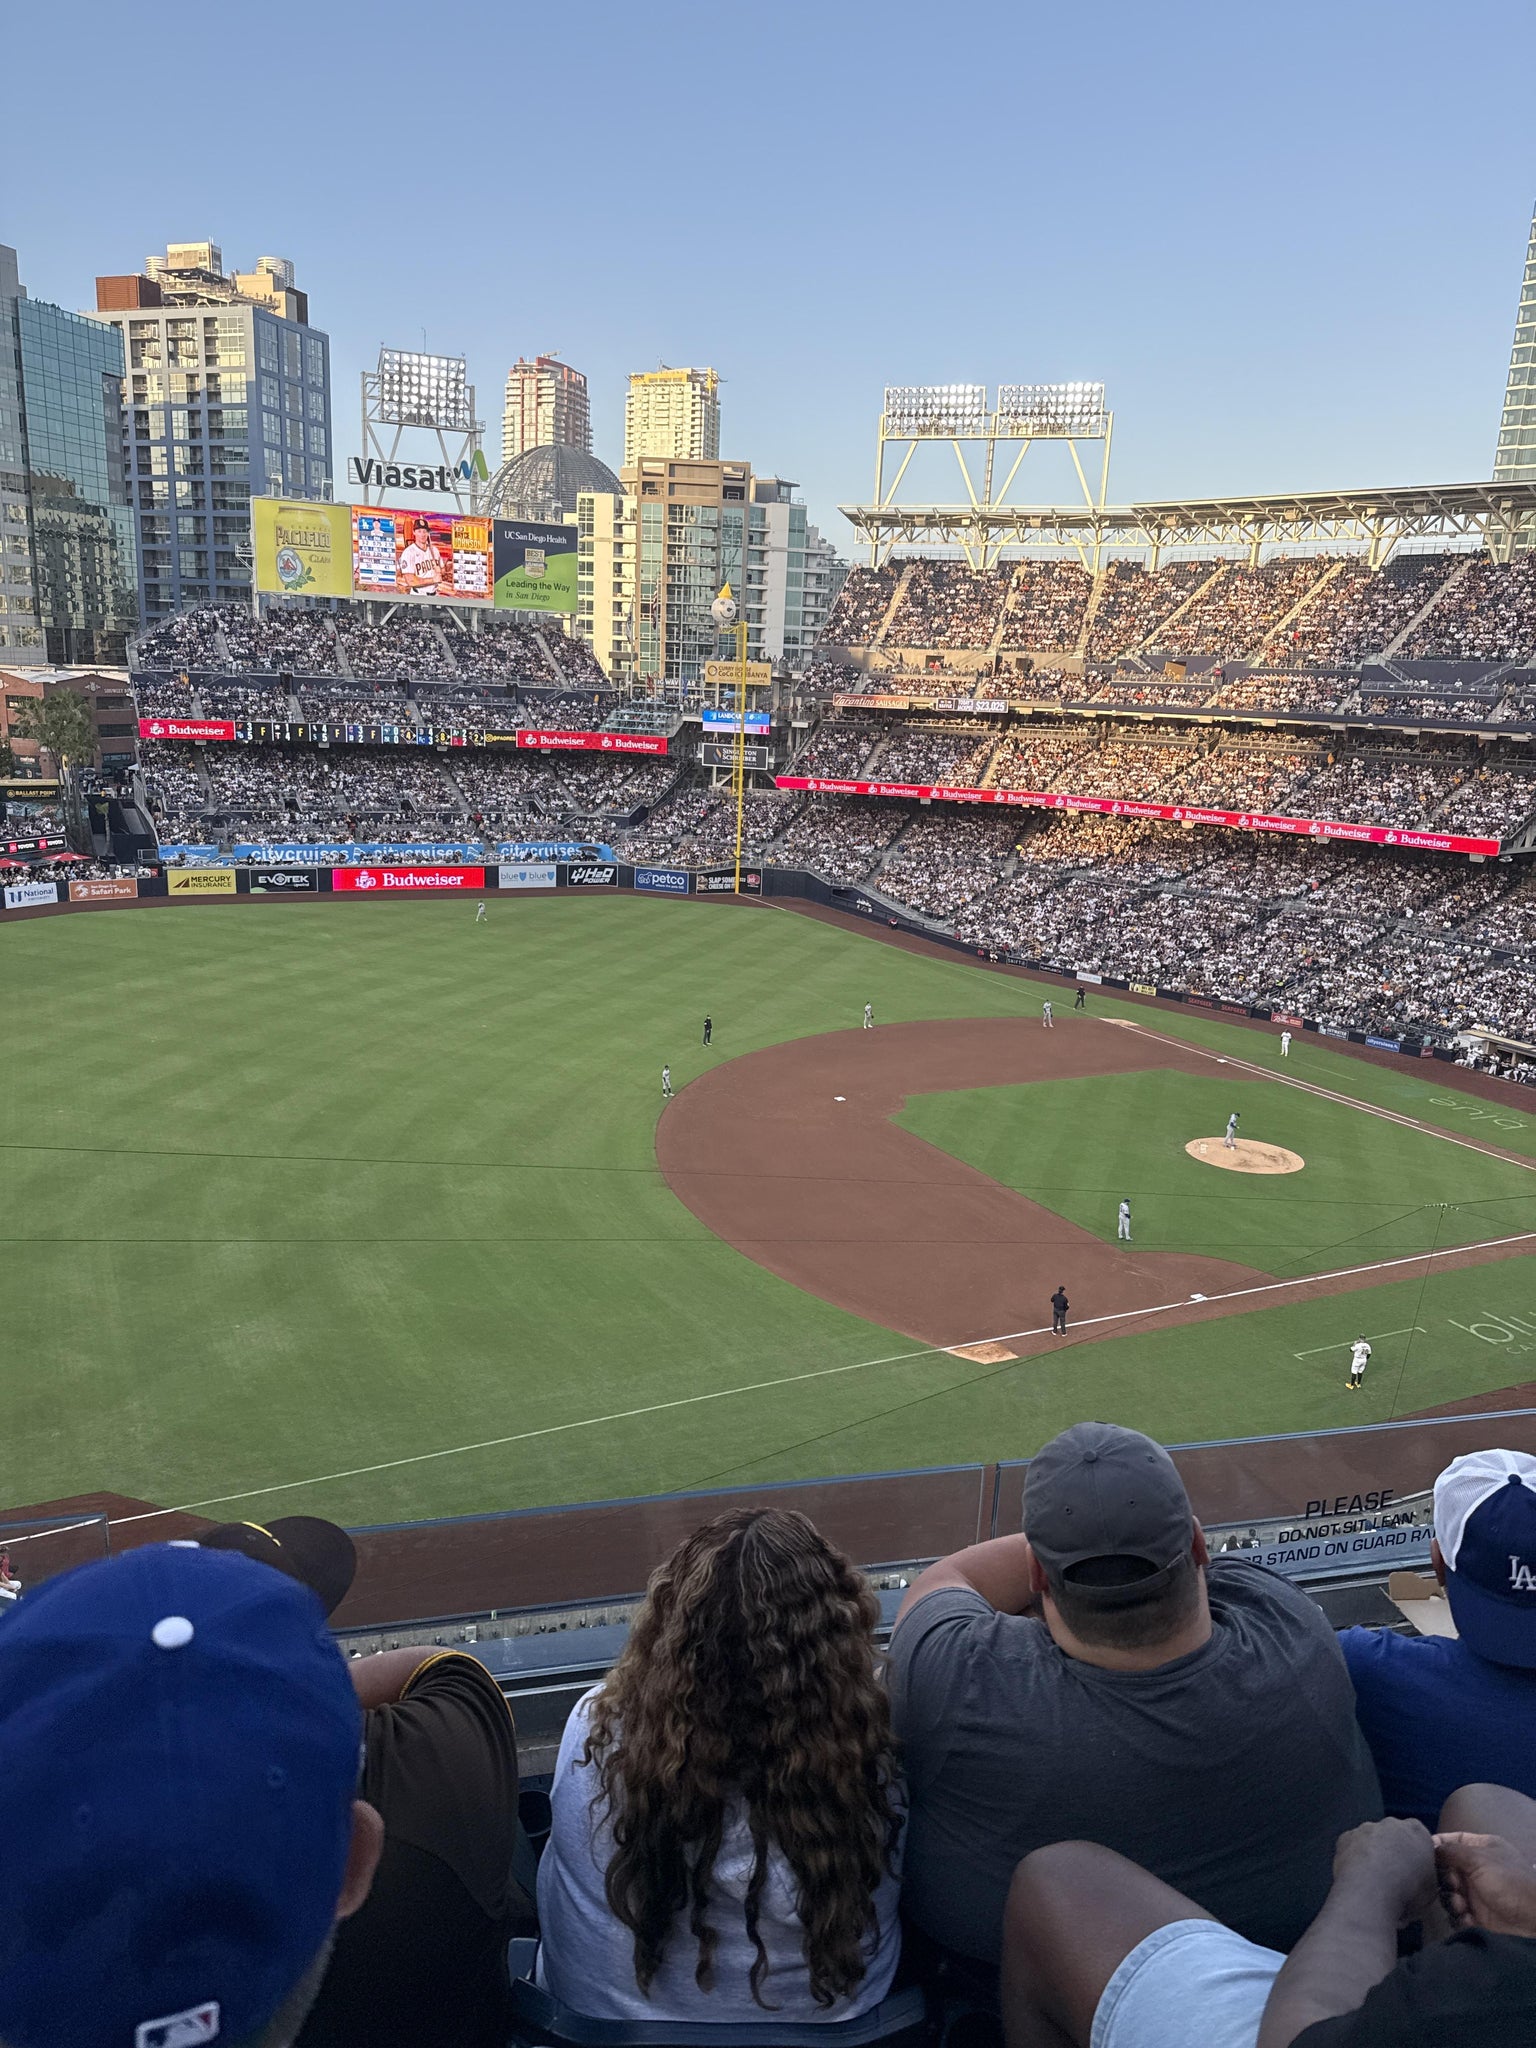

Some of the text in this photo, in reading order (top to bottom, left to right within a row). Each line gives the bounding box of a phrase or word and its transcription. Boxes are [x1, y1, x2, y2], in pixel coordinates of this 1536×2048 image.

[354, 457, 450, 491] Viasat
[504, 531, 567, 544] UC San Diego Health
[506, 580, 571, 593] Leading the Way
[531, 593, 550, 602] Diego
[836, 695, 875, 706] Tarantino
[168, 725, 225, 735] Budweiser
[260, 727, 265, 736] F
[298, 728, 303, 737] F
[322, 724, 327, 732] 4
[335, 729, 340, 737] F
[358, 726, 363, 734] 3
[247, 732, 253, 740] 5
[322, 733, 328, 742] 5
[358, 735, 364, 743] 2
[371, 730, 376, 739] F
[428, 737, 433, 745] 3
[540, 736, 585, 745] Budweiser
[616, 739, 658, 750] Budweiser
[820, 782, 857, 791] Budweiser
[880, 786, 919, 795] Budweiser
[943, 790, 982, 799] Budweiser
[1008, 794, 1046, 803] Budweiser
[1067, 799, 1102, 809] Budweiser
[1124, 805, 1162, 816] Budweiser
[1185, 811, 1226, 823] Budweiser
[1252, 818, 1296, 830] Budweiser
[1324, 826, 1371, 839] Budweiser
[1401, 834, 1452, 848] Budweiser
[500, 872, 518, 880] blue
[585, 868, 614, 878] H2O
[382, 873, 464, 886] Budweiser
[652, 874, 684, 885] petco
[24, 887, 53, 897] National
[1305, 1489, 1394, 1519] PLEASE
[1278, 1530, 1301, 1544] DO
[1305, 1523, 1340, 1540] NOT
[1373, 1512, 1415, 1529] LEAN
[1267, 1547, 1321, 1566] STAND
[1325, 1542, 1349, 1556] ON
[1353, 1533, 1407, 1552] GUARD
[1508, 1555, 1536, 1590] LA
